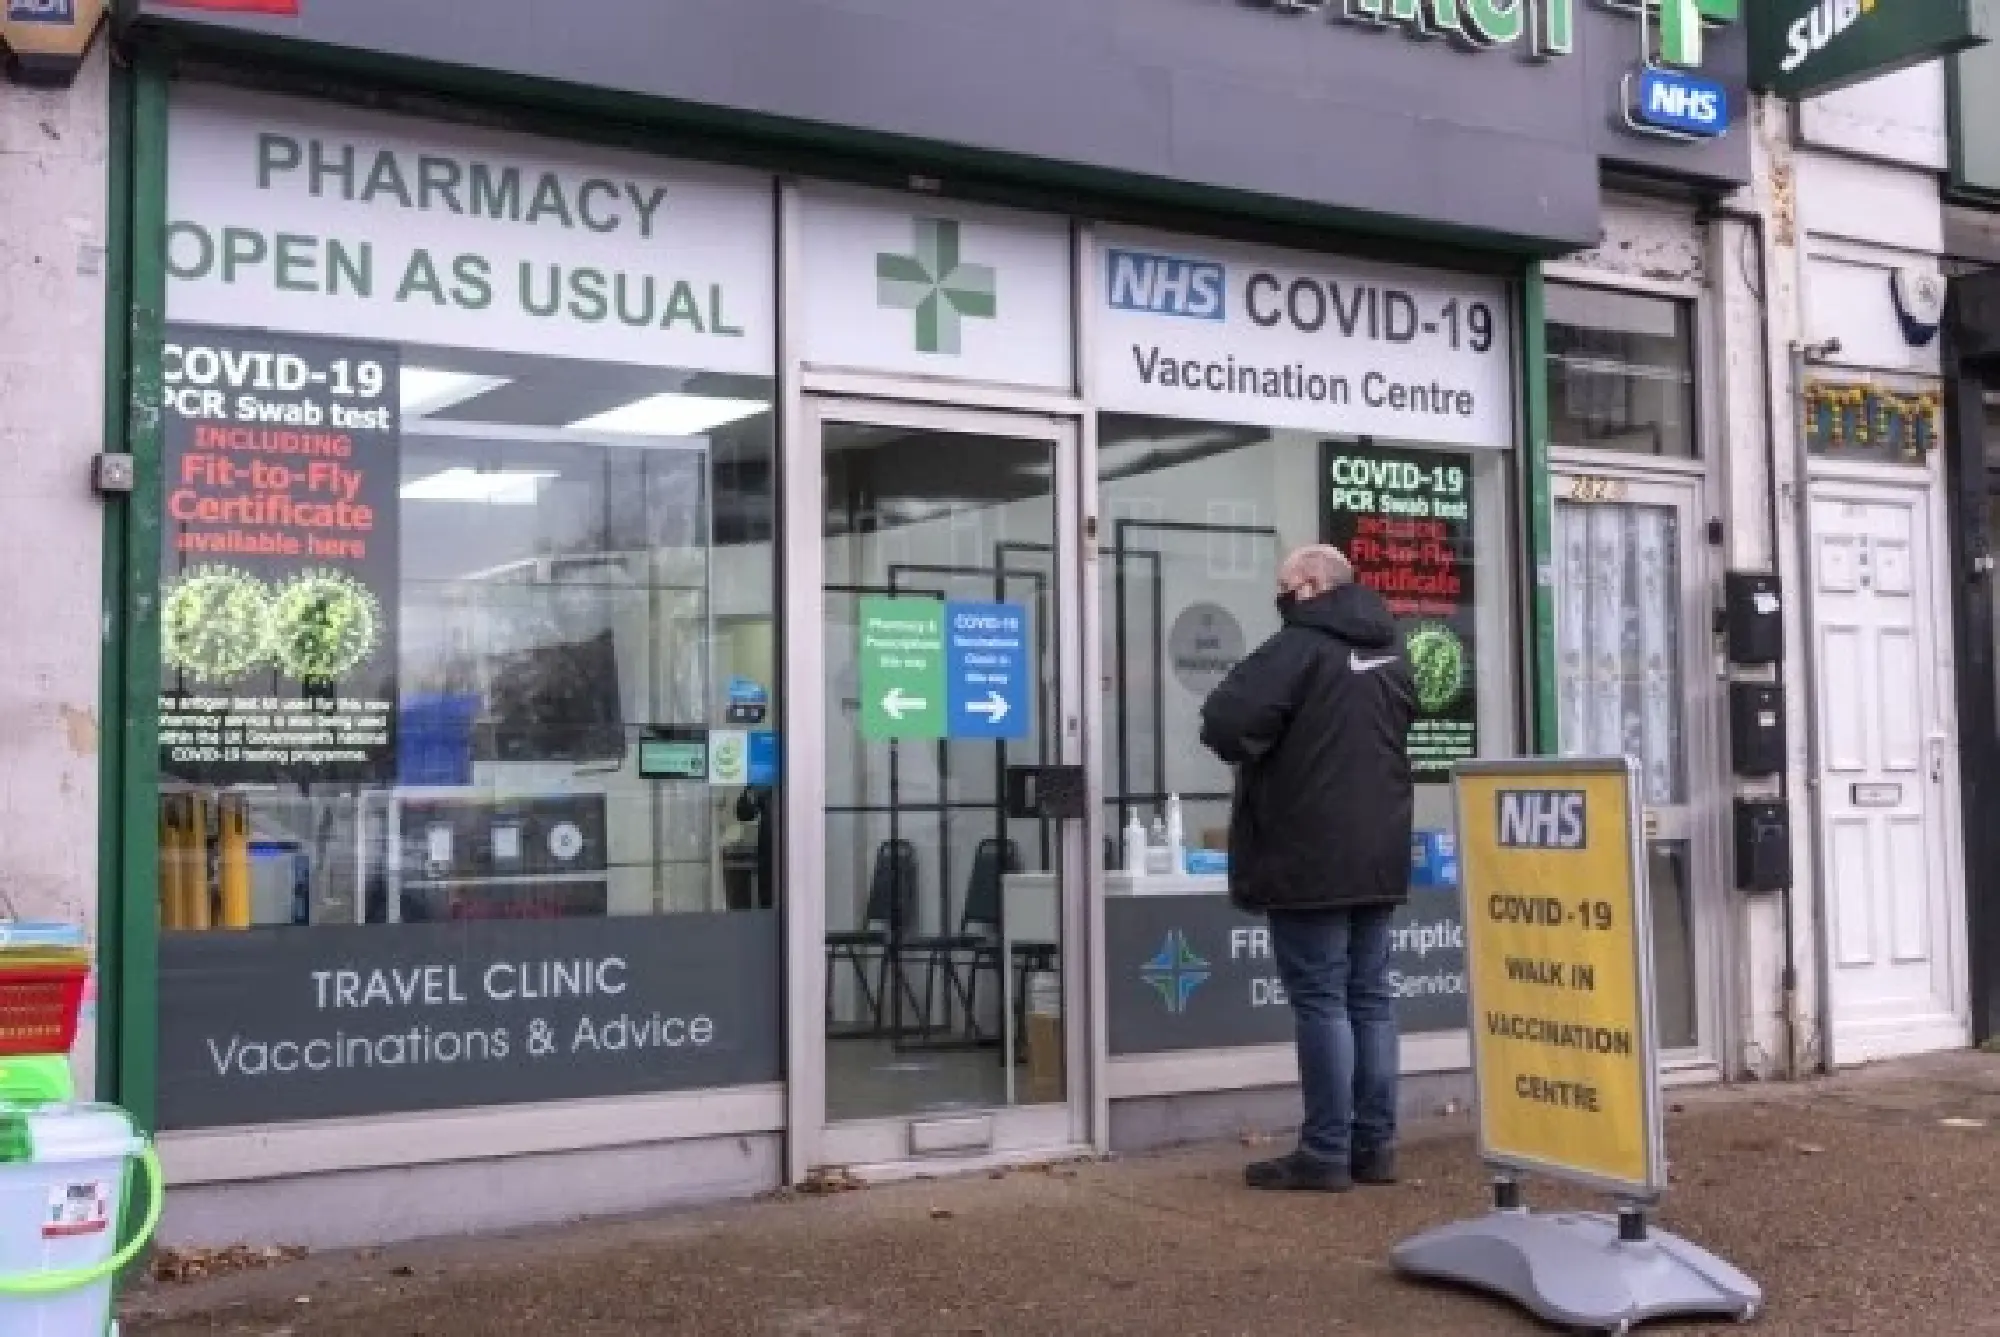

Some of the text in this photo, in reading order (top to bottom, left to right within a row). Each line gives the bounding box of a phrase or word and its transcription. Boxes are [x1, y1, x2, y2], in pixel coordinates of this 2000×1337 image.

[1779, 0, 1876, 70] SUB
[1651, 80, 1717, 123] NHS
[258, 132, 668, 239] PHARMACY
[165, 220, 744, 337] OPEN AS USUAL
[1110, 253, 1494, 353] NHS COVID-19
[163, 343, 384, 398] COVID-19
[1132, 345, 1475, 417] Vaccination Centre
[236, 396, 323, 425] Swab
[330, 404, 390, 430] test
[195, 426, 352, 457] INCLUDING
[182, 454, 363, 499] Fit-to-Fly
[1332, 455, 1464, 496] COVID-19
[169, 488, 374, 531] Certificate
[1332, 488, 1467, 519] PCR Swab test
[176, 530, 366, 559] available here
[1358, 566, 1462, 593] ertificate
[1501, 792, 1583, 848] NHS
[312, 957, 628, 1009] TRAVEL CLINIC
[1505, 957, 1595, 992] WALK IN
[207, 1011, 714, 1076] Vaccinations & Advice
[1486, 1010, 1633, 1058] VACCINATION
[1515, 1073, 1602, 1113] CENTRE
